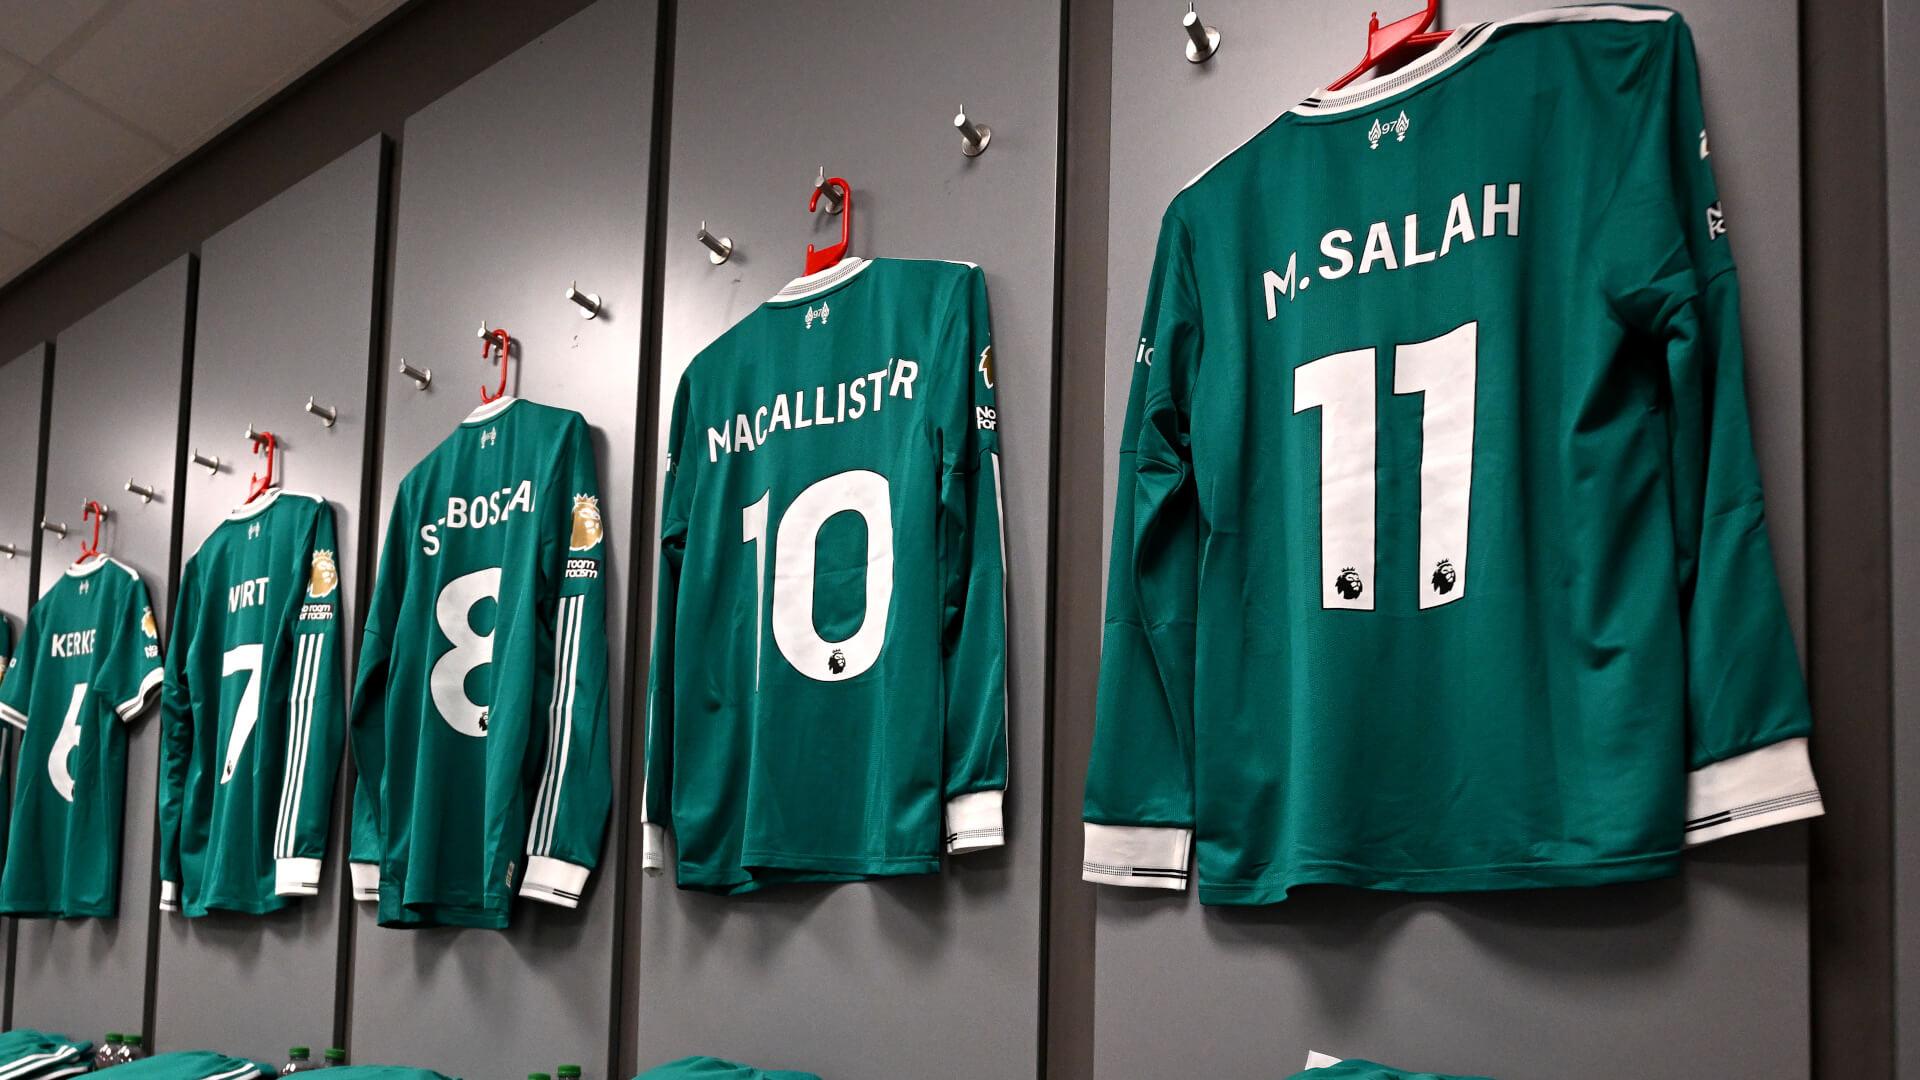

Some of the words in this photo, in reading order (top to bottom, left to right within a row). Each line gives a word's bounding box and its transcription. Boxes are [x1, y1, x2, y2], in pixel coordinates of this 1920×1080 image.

[1293, 321, 1478, 611] 11
[567, 559, 596, 569] room
[742, 469, 895, 691] 10
[220, 643, 264, 785] 7
[430, 567, 503, 738] 8
